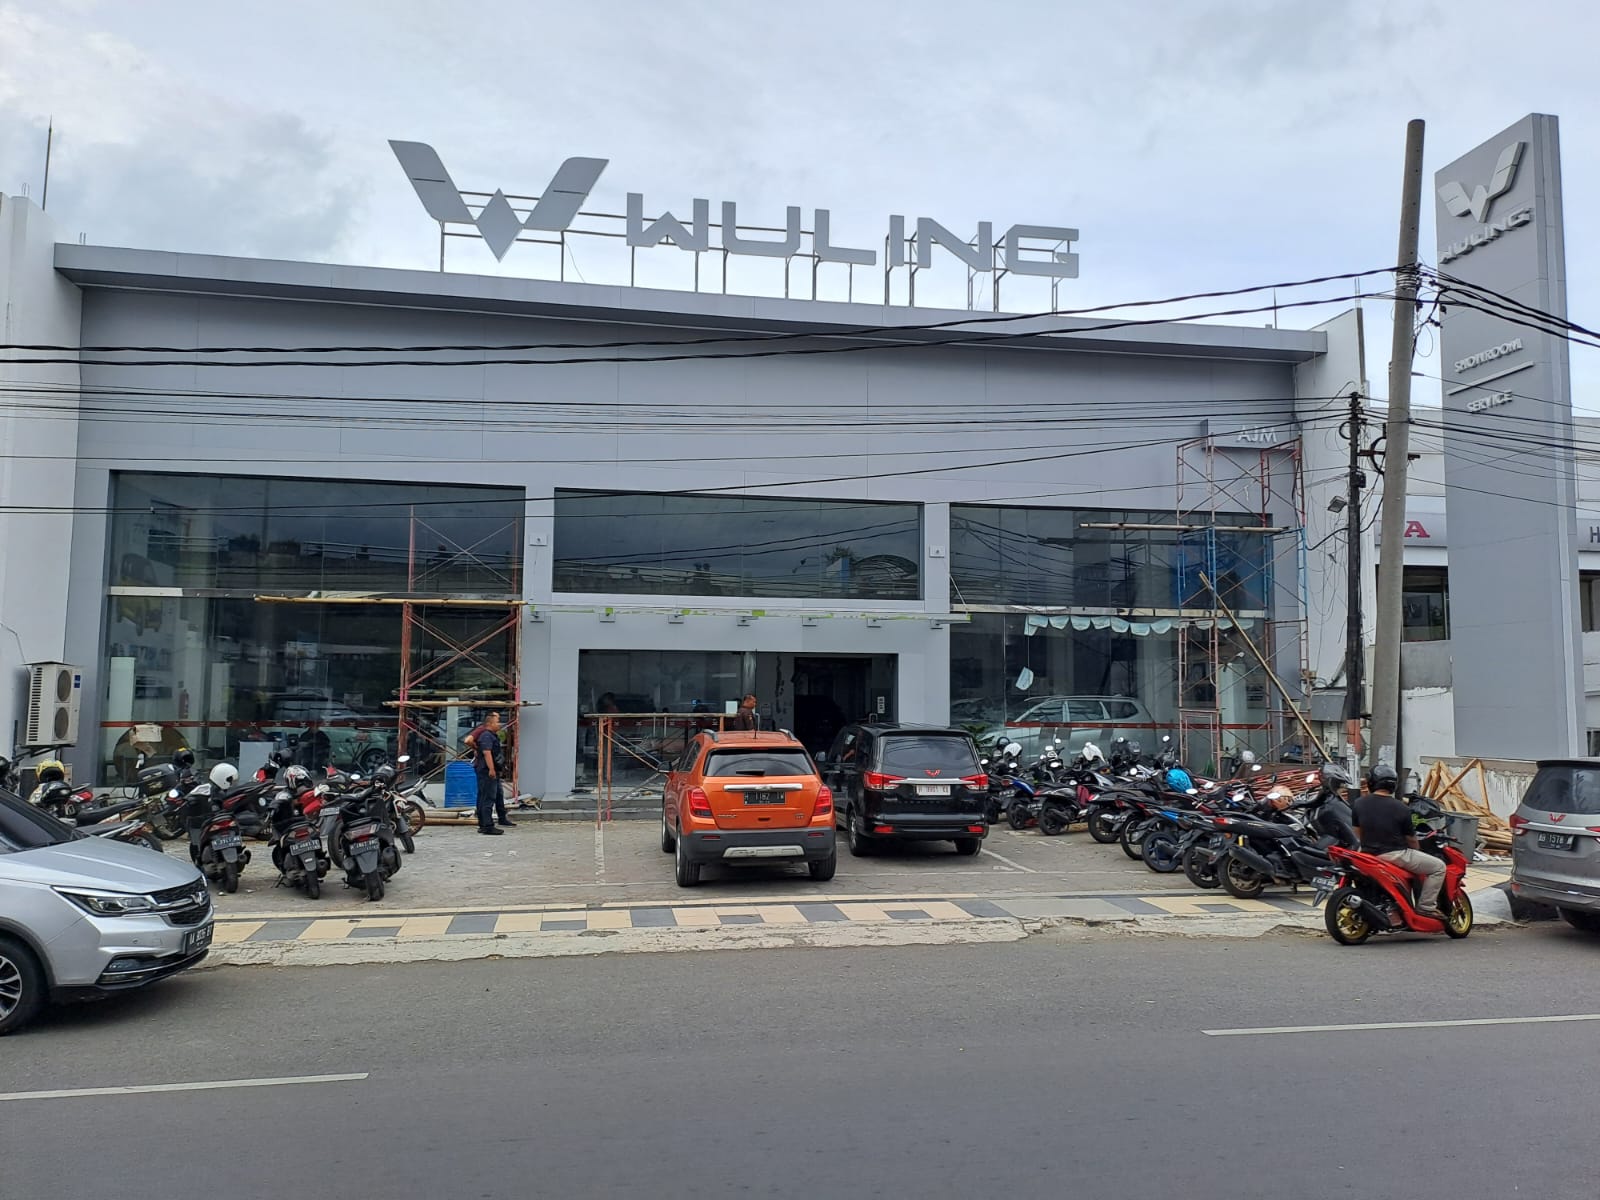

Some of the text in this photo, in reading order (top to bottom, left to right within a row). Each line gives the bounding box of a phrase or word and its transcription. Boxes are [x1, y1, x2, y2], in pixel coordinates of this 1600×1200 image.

[627, 192, 1079, 278] WULING
[1466, 389, 1513, 412] SERVICE
[1236, 425, 1278, 443] AJM
[1403, 520, 1431, 538] A
